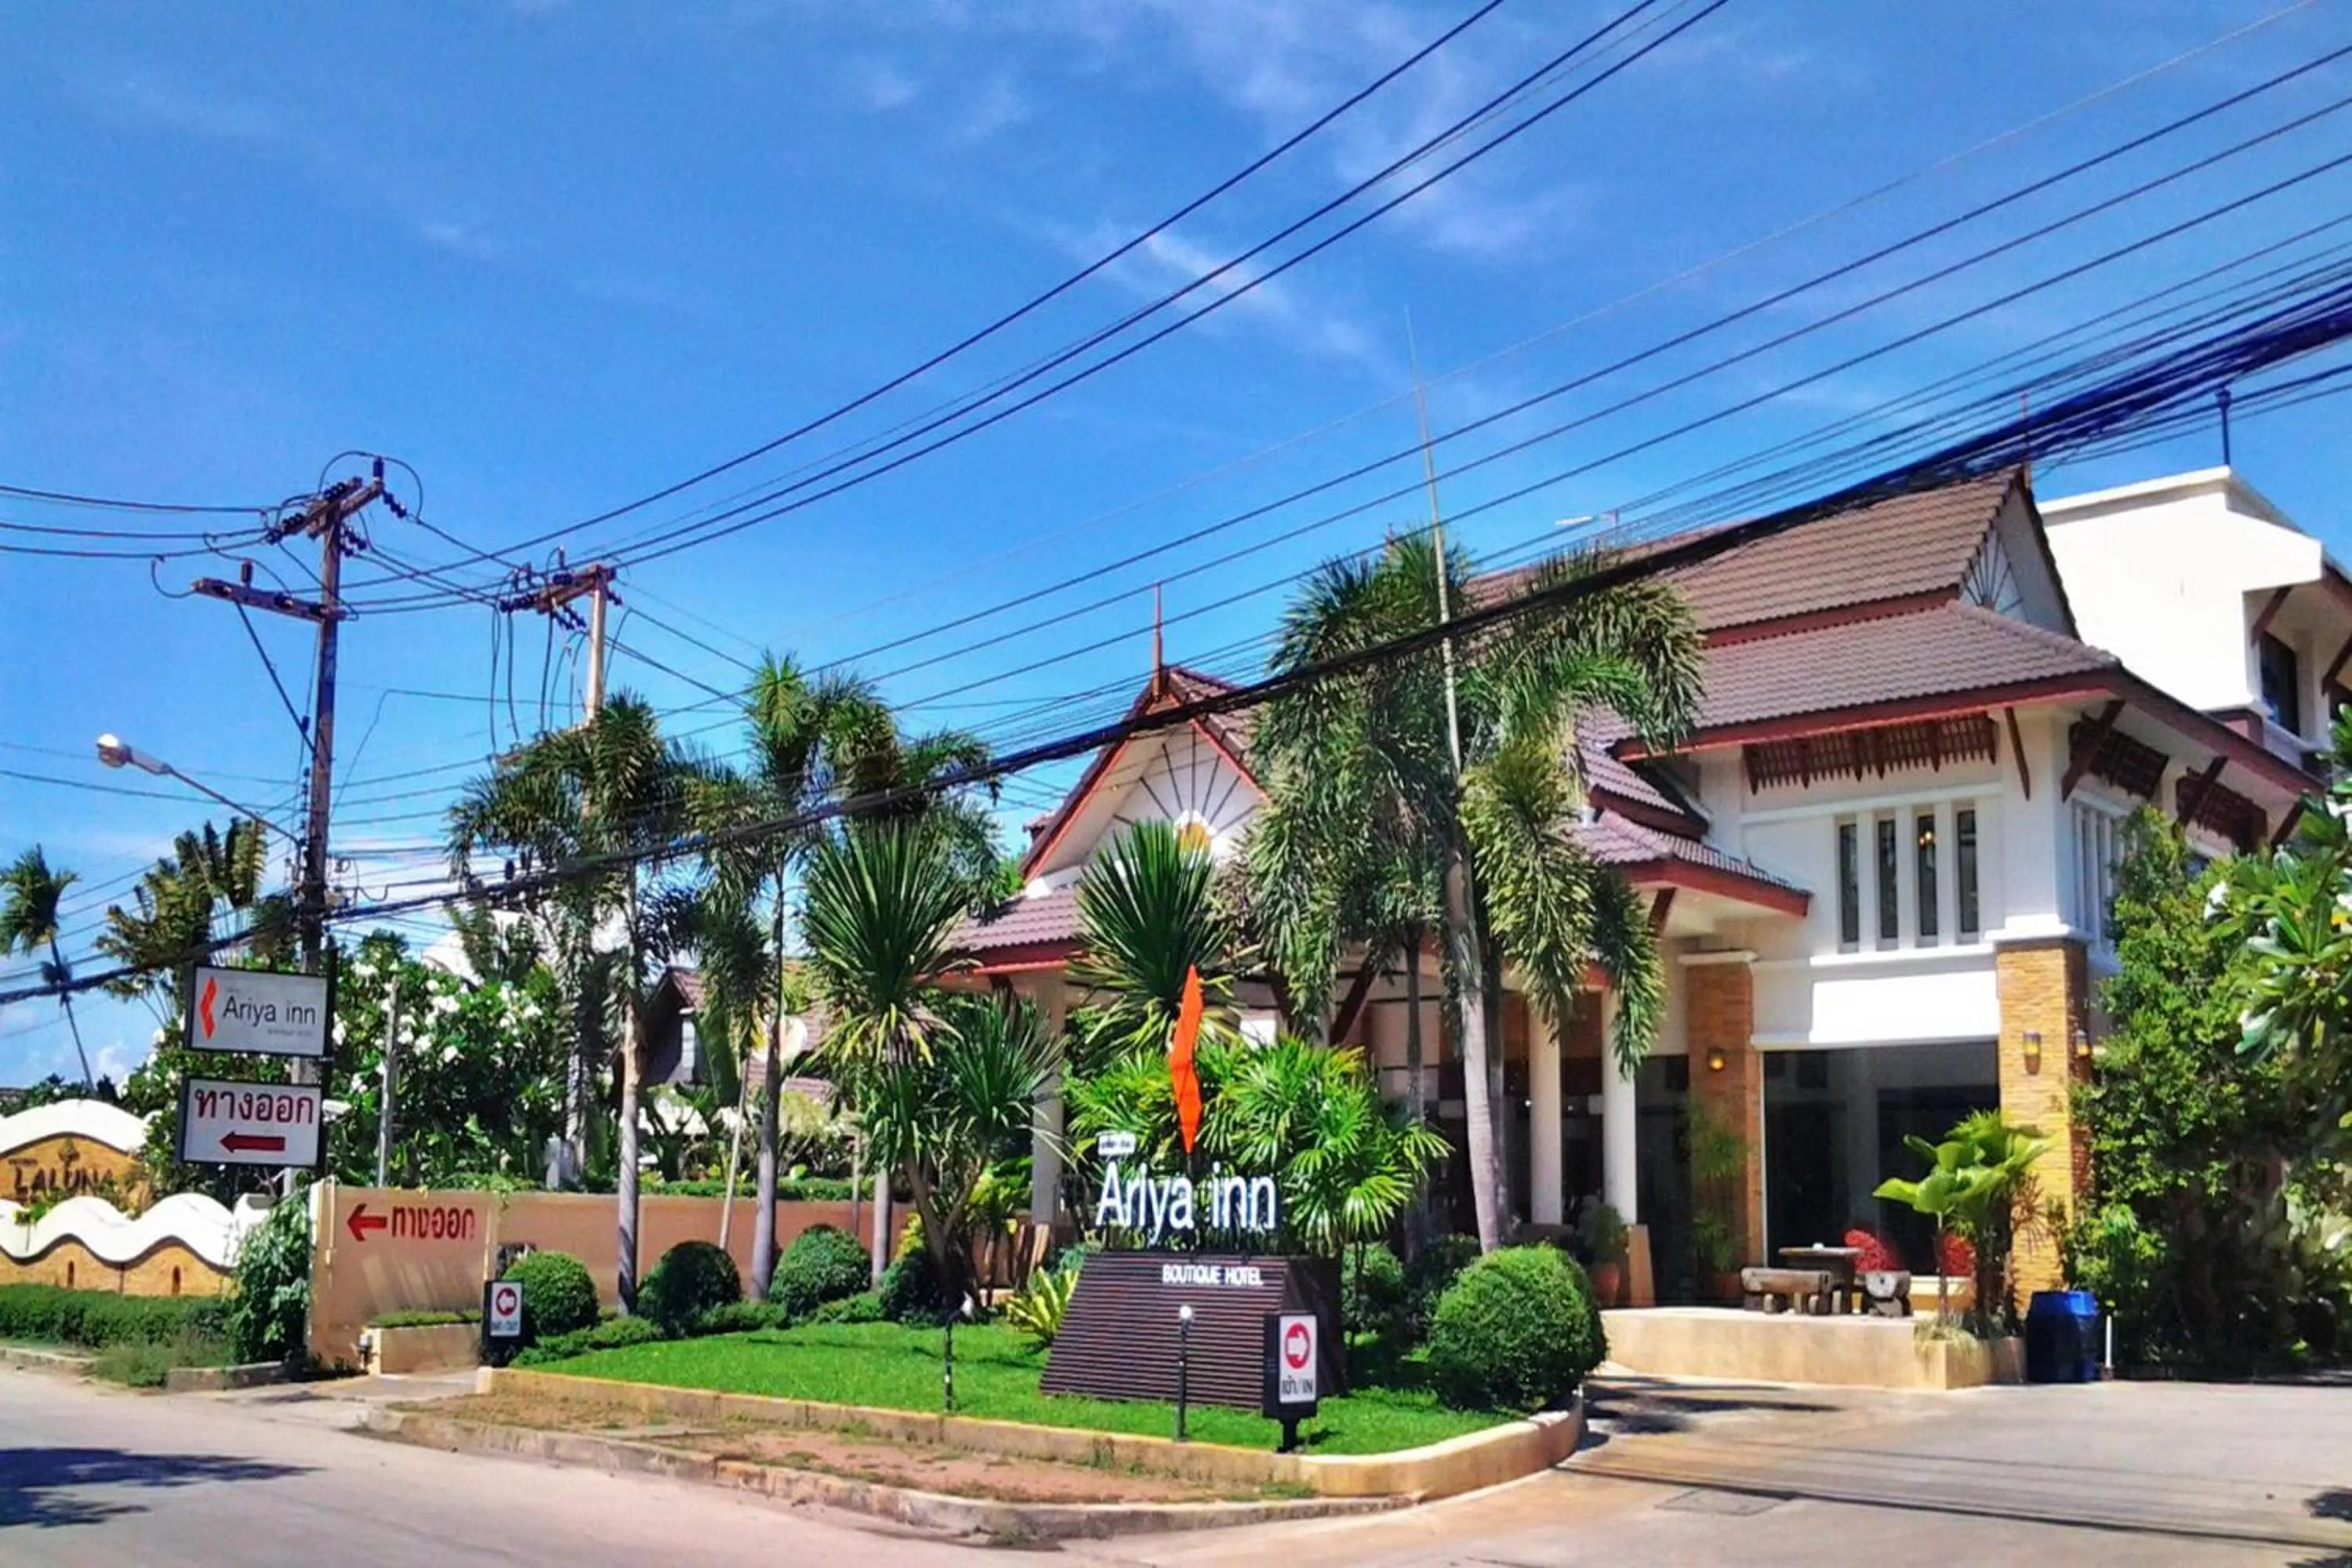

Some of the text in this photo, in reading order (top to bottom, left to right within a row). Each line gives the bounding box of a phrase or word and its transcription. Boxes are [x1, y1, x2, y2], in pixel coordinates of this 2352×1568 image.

[223, 995, 316, 1028] Ariya inn
[195, 1089, 314, 1124] ทางออก
[1096, 1161, 1276, 1245] Ariya inn
[391, 1206, 475, 1240] ทางออก
[1162, 1264, 1264, 1286] BOUTIQUE HOTEL
